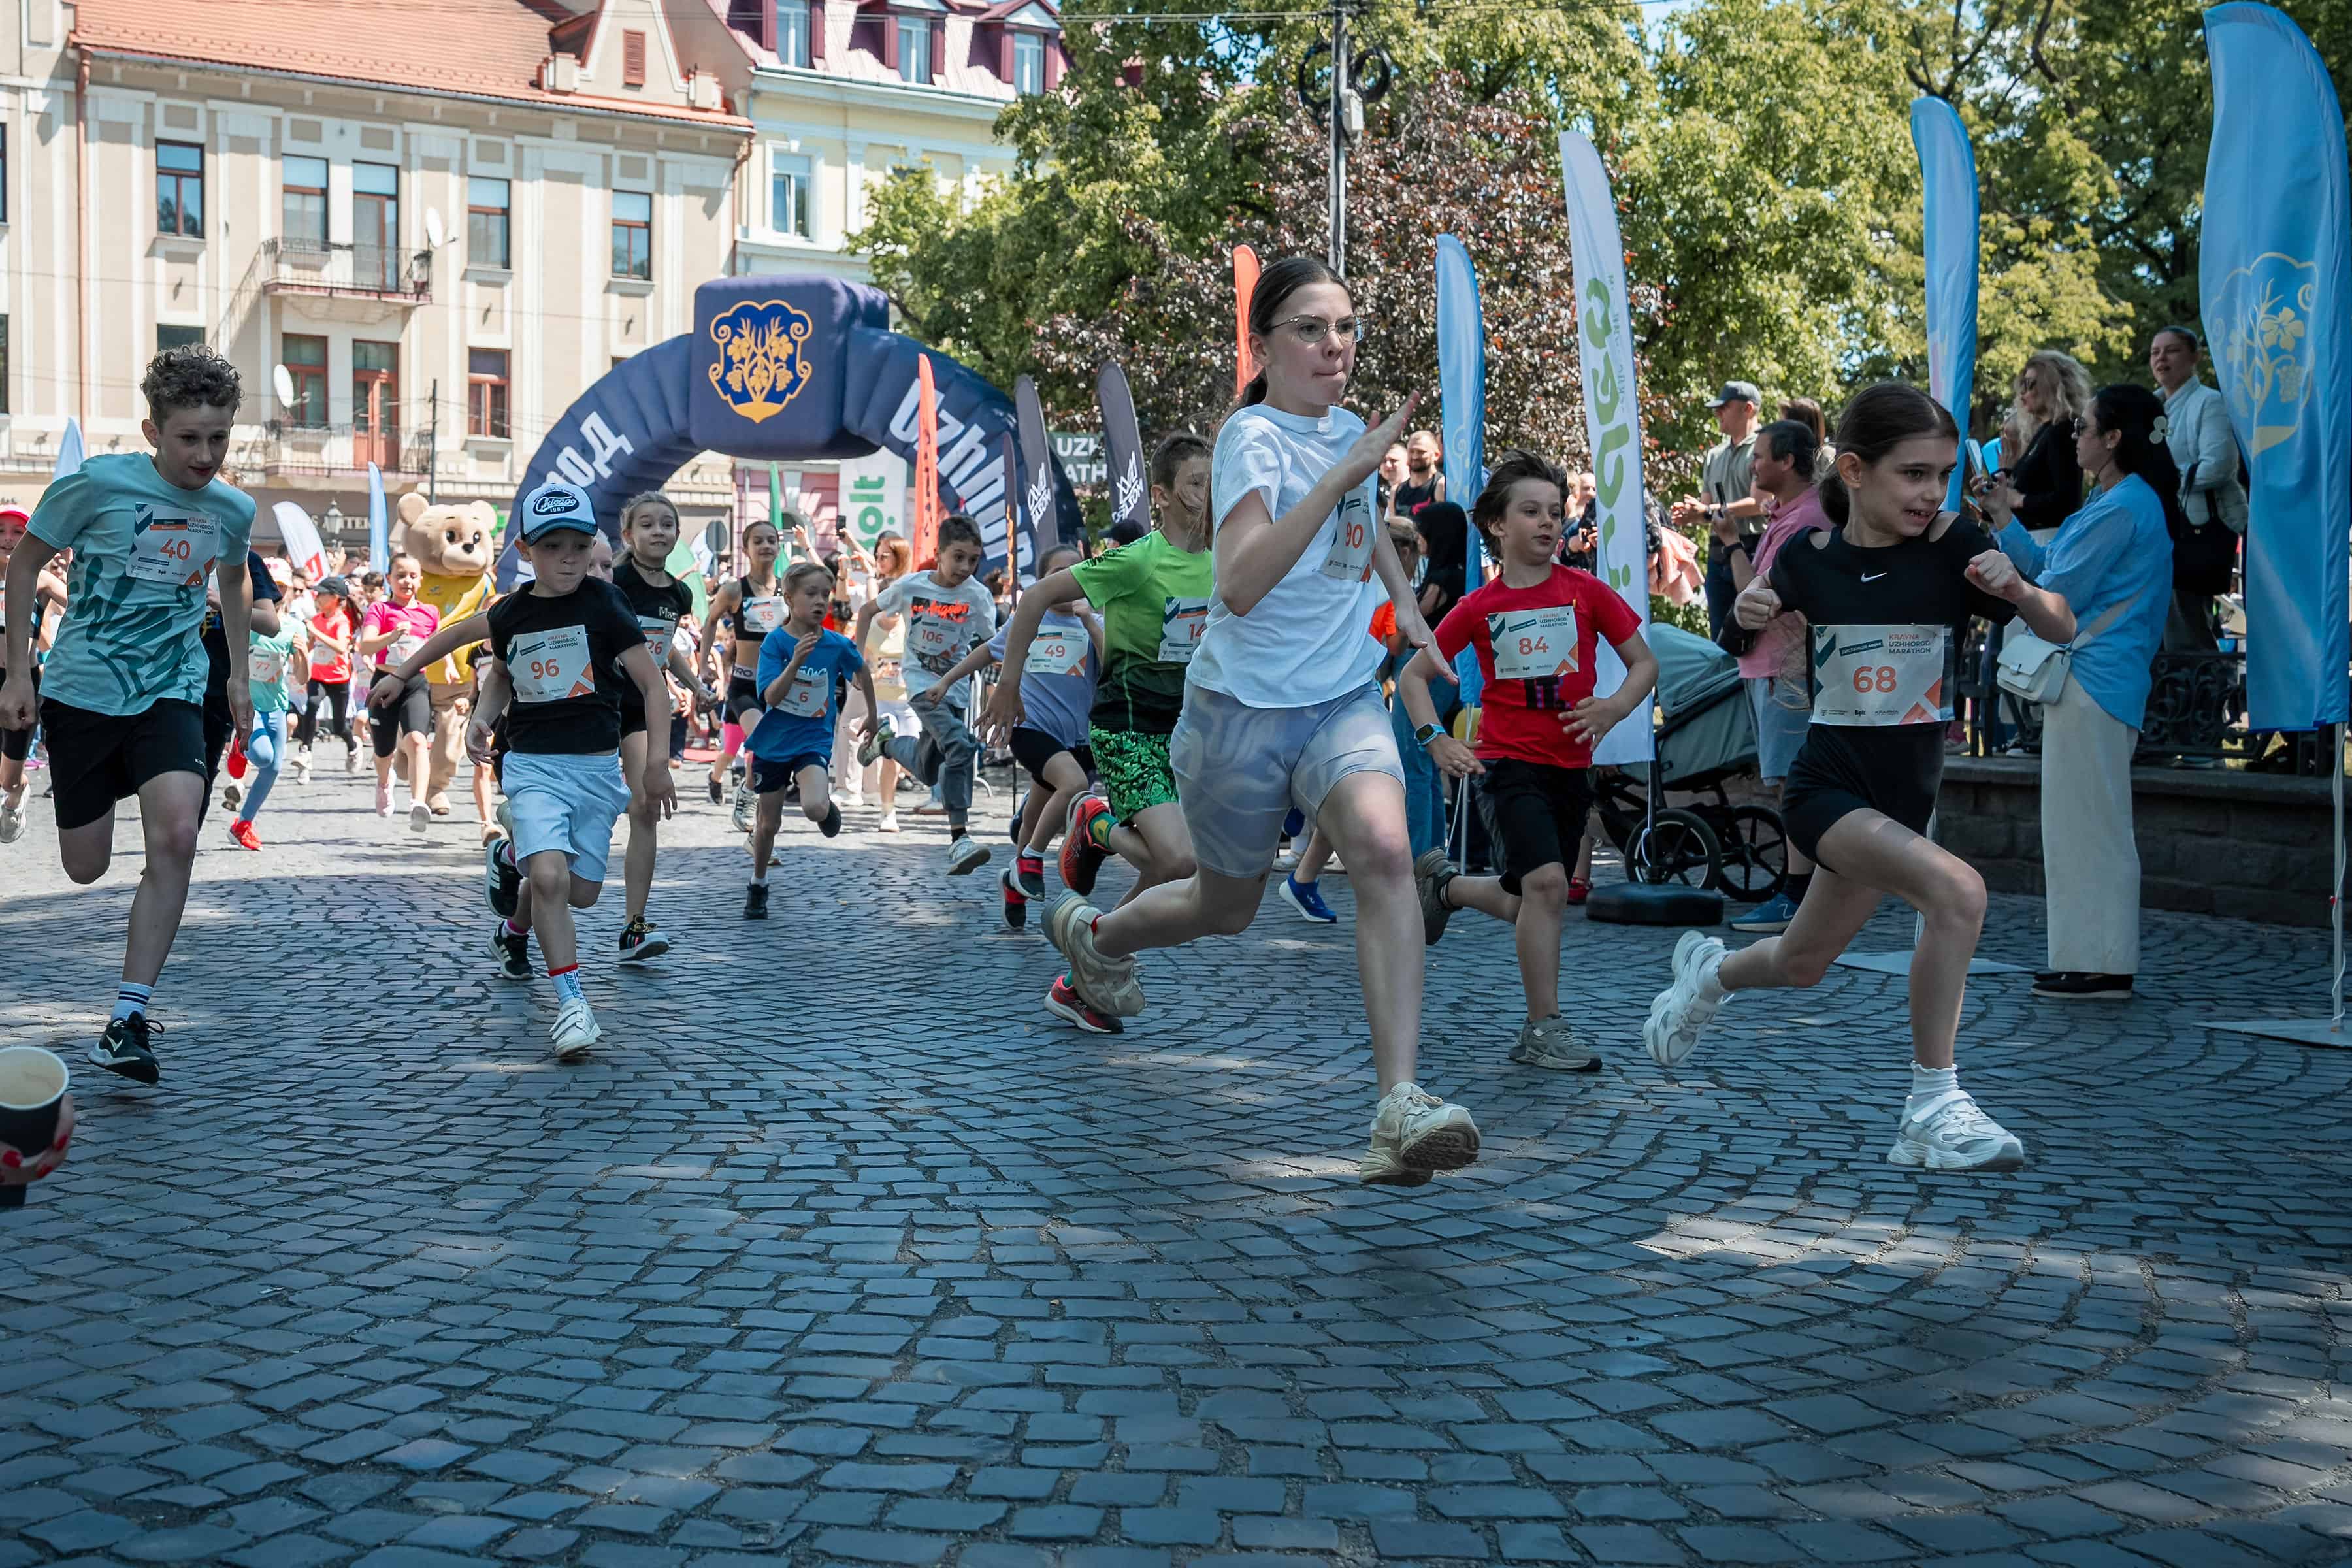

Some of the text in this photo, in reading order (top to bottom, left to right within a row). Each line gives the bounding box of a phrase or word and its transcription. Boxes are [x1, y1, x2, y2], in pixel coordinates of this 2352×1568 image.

[1345, 521, 1364, 549] 90
[160, 538, 191, 561] 40
[759, 611, 774, 621] 35
[921, 629, 943, 644] 106
[549, 642, 578, 650] MARATHON
[1044, 644, 1066, 658] 49
[1518, 636, 1549, 655] 84
[531, 658, 560, 679] 96
[1853, 666, 1897, 693] 68
[799, 692, 809, 703] 6
